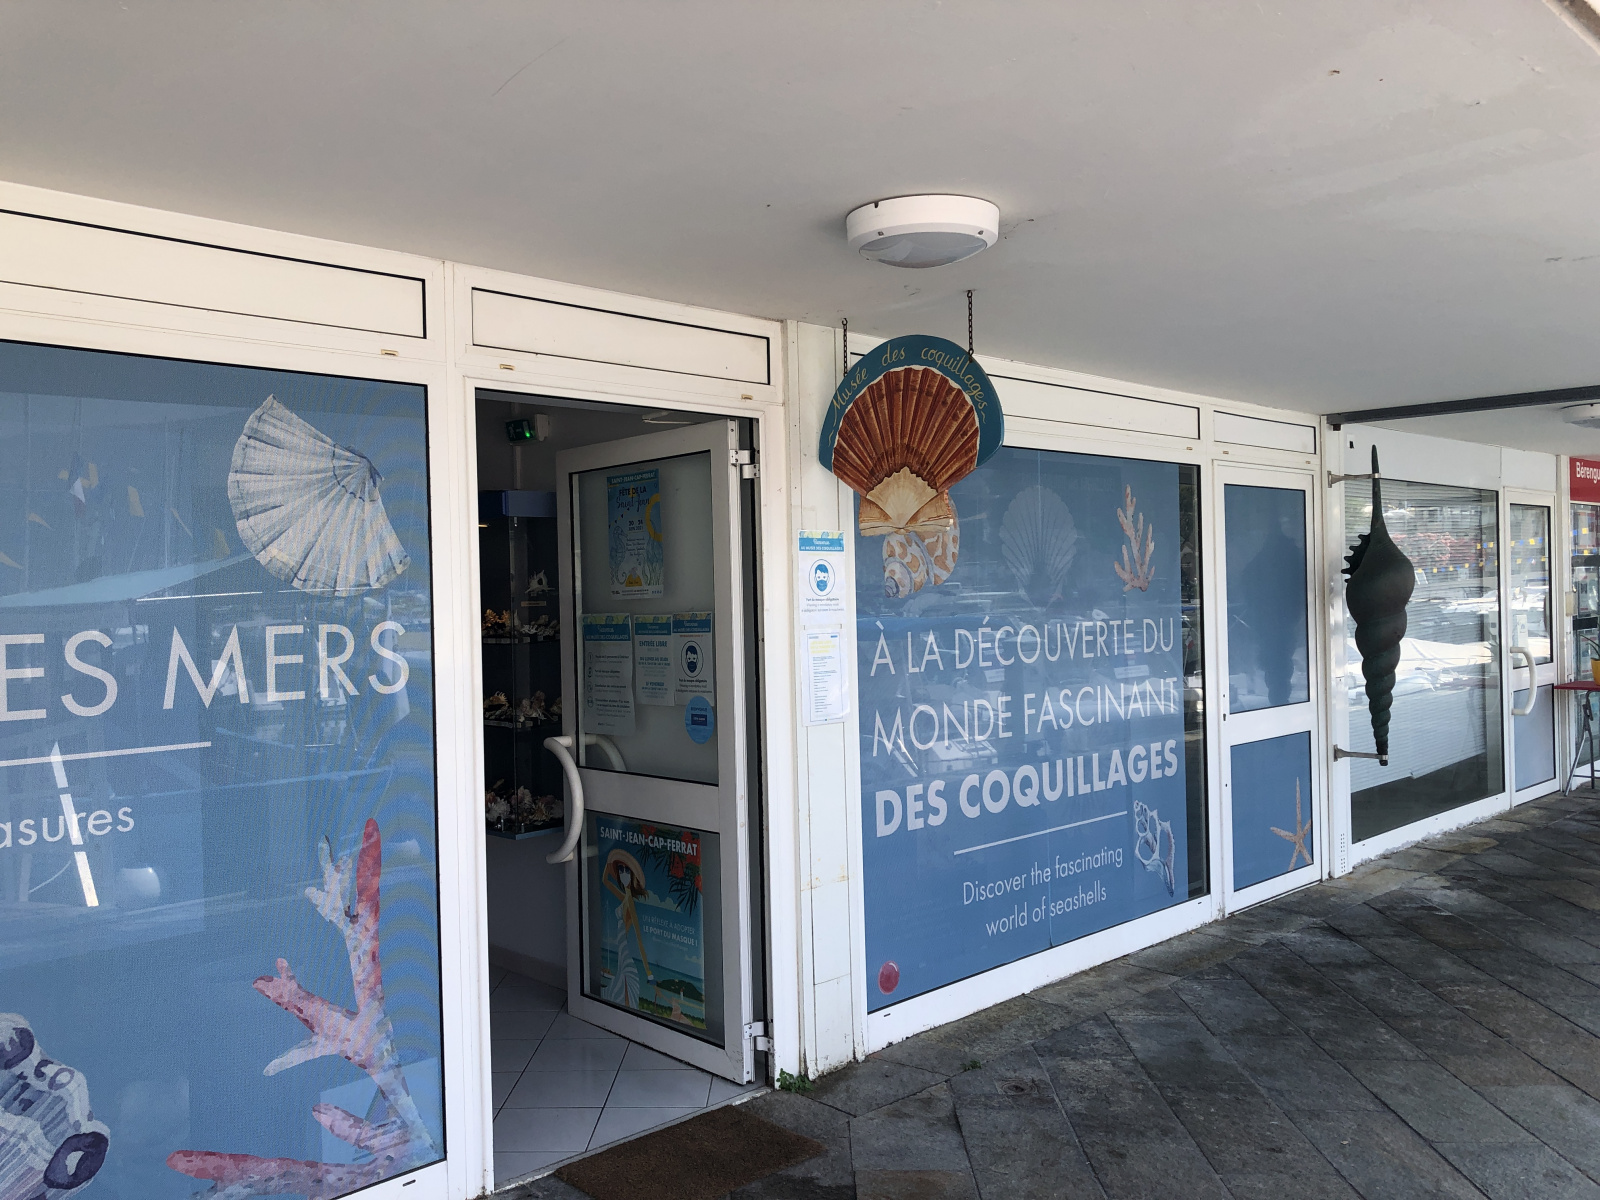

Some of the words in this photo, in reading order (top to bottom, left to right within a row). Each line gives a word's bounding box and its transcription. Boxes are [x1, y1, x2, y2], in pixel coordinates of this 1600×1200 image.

[832, 366, 869, 427] Musée
[881, 343, 906, 367] des
[920, 347, 988, 410] coquillages
[163, 621, 410, 710] MERS
[870, 620, 896, 677] À
[907, 630, 944, 673] LA
[955, 616, 1134, 670] DÉCOUVERTE
[1143, 617, 1174, 653] DU
[872, 695, 1013, 757] MONDE
[1024, 677, 1178, 735] FASCINANT
[875, 779, 948, 838] DES
[959, 739, 1178, 818] COQUILLAGES
[600, 827, 697, 855] SAINT-JEAN-CAP-FERRAT
[963, 872, 1027, 905] Discover
[1031, 861, 1051, 886] the
[1055, 846, 1123, 879] fascinating
[650, 926, 663, 937] PORT
[663, 931, 671, 939] DU
[671, 933, 695, 946] MASQUE
[986, 901, 1028, 937] world
[1032, 896, 1046, 923] of
[1050, 880, 1107, 917] seashells
